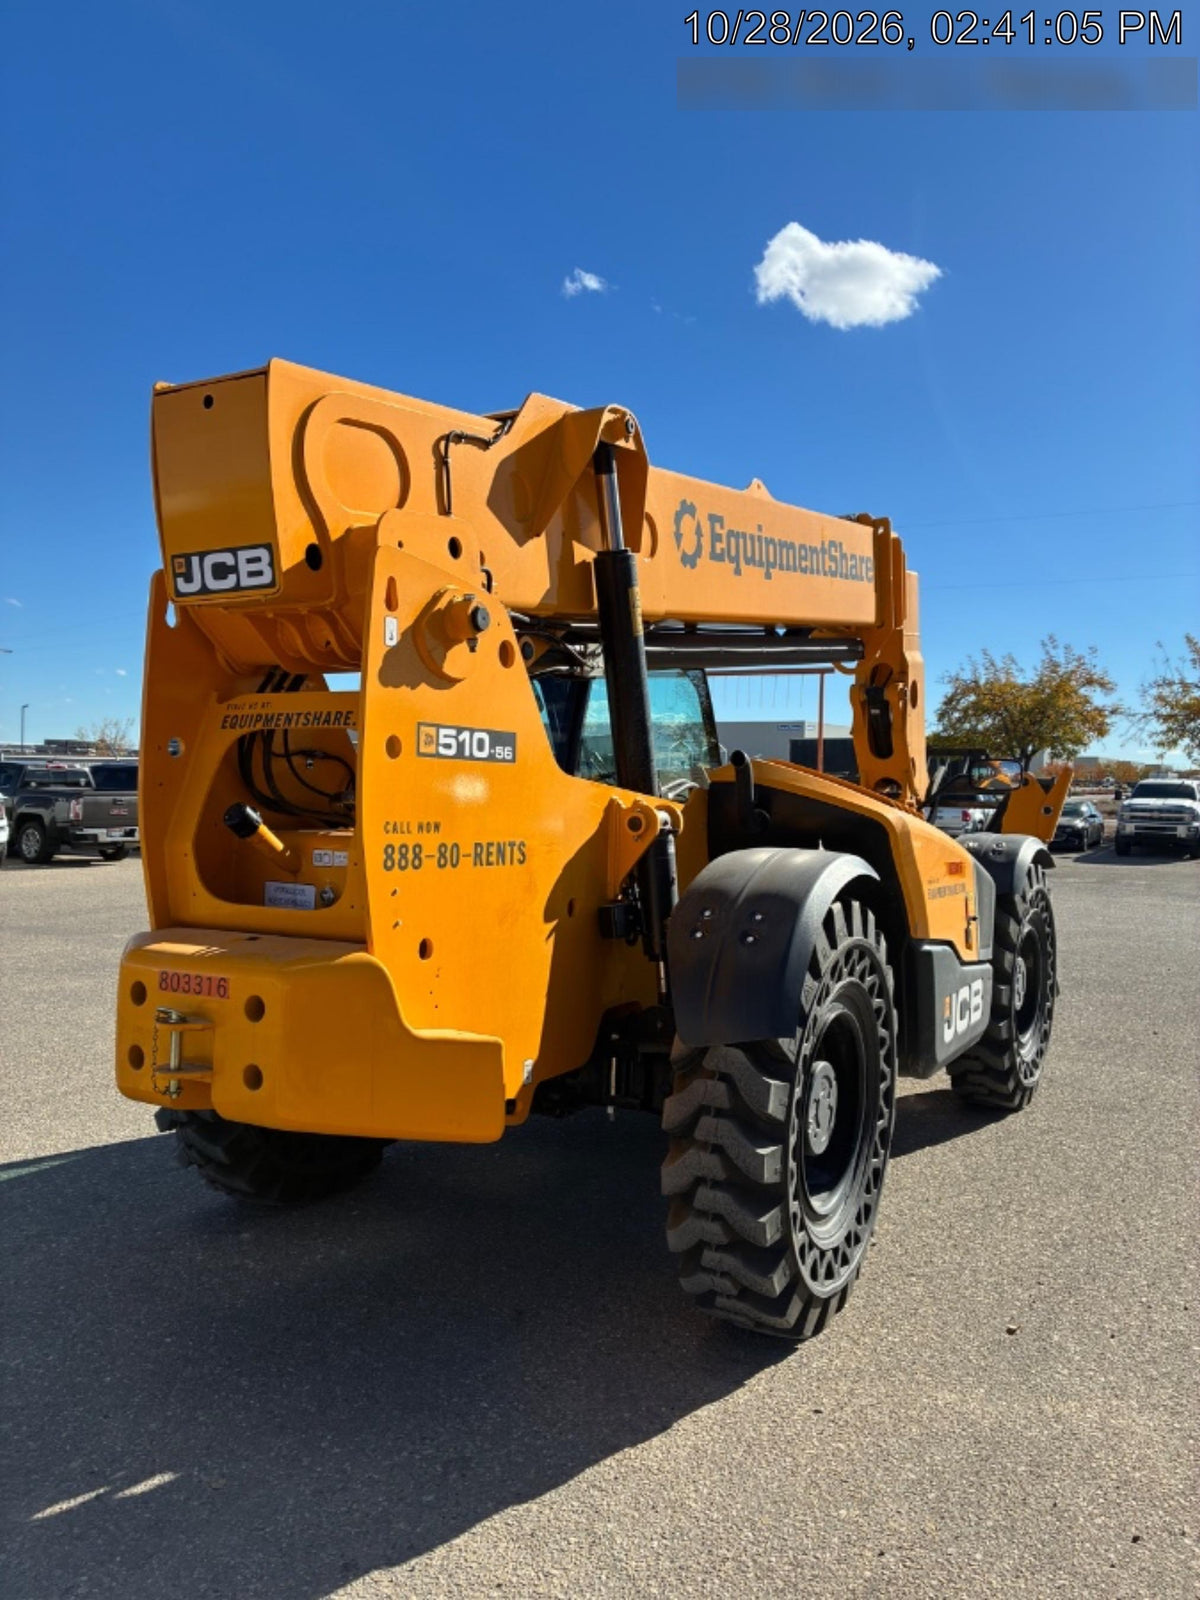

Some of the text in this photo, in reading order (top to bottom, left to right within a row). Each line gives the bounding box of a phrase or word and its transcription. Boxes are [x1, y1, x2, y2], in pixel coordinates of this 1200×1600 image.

[707, 512, 874, 583] EquipmentShare
[176, 547, 273, 593] JCB
[438, 727, 513, 760] 510-56
[383, 820, 442, 835] CALL NOW
[383, 840, 527, 872] 888-80-RENTS
[159, 971, 228, 999] 803316
[943, 977, 984, 1044] JCB
